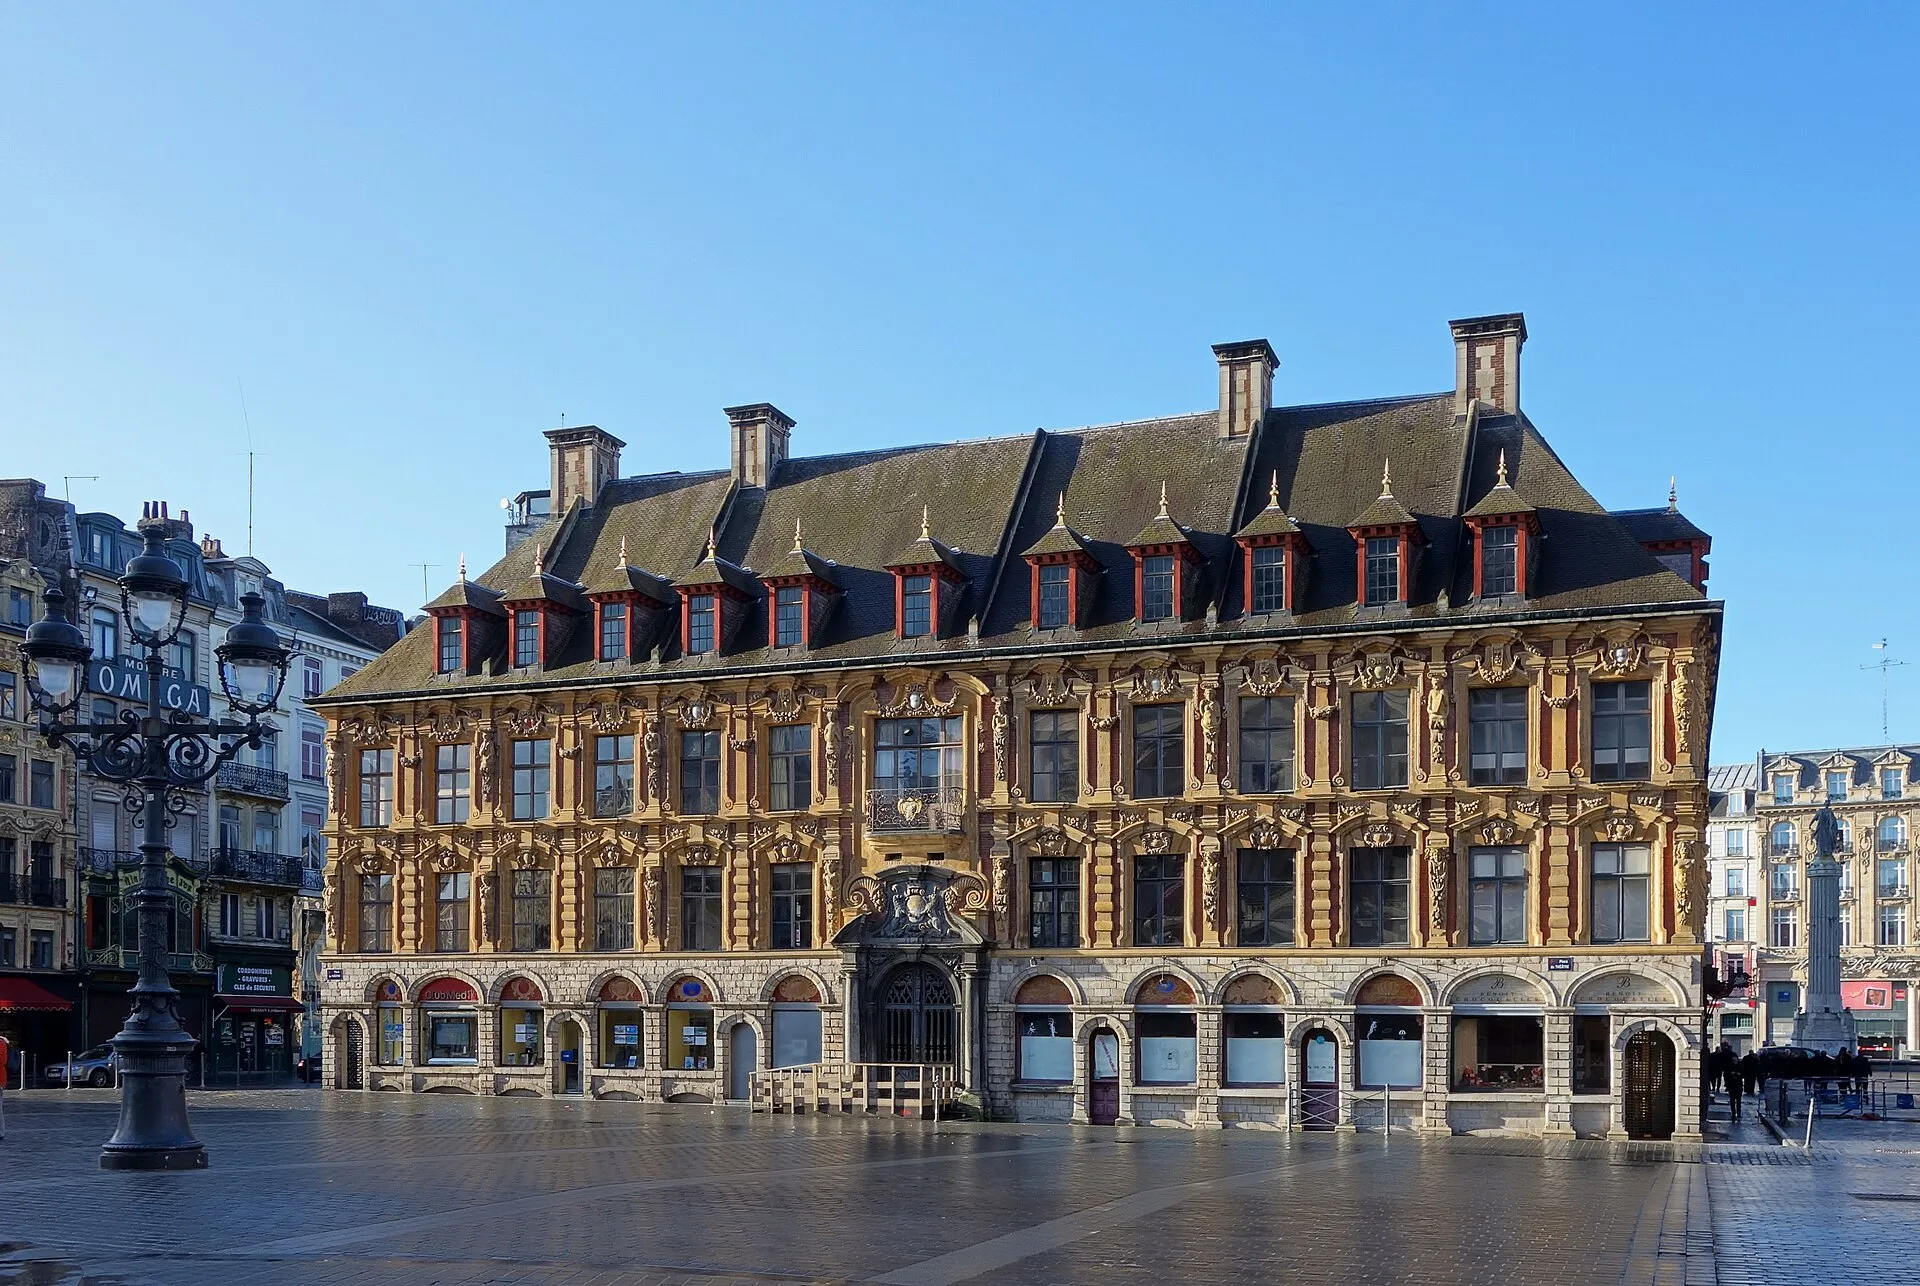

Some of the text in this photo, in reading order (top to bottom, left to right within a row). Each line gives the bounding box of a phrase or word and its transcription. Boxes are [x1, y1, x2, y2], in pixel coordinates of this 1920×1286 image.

[125, 658, 178, 679] MORE
[99, 665, 201, 713] OMGA
[237, 967, 273, 975] CORDONNERIE
[241, 975, 268, 983] GRAVURES
